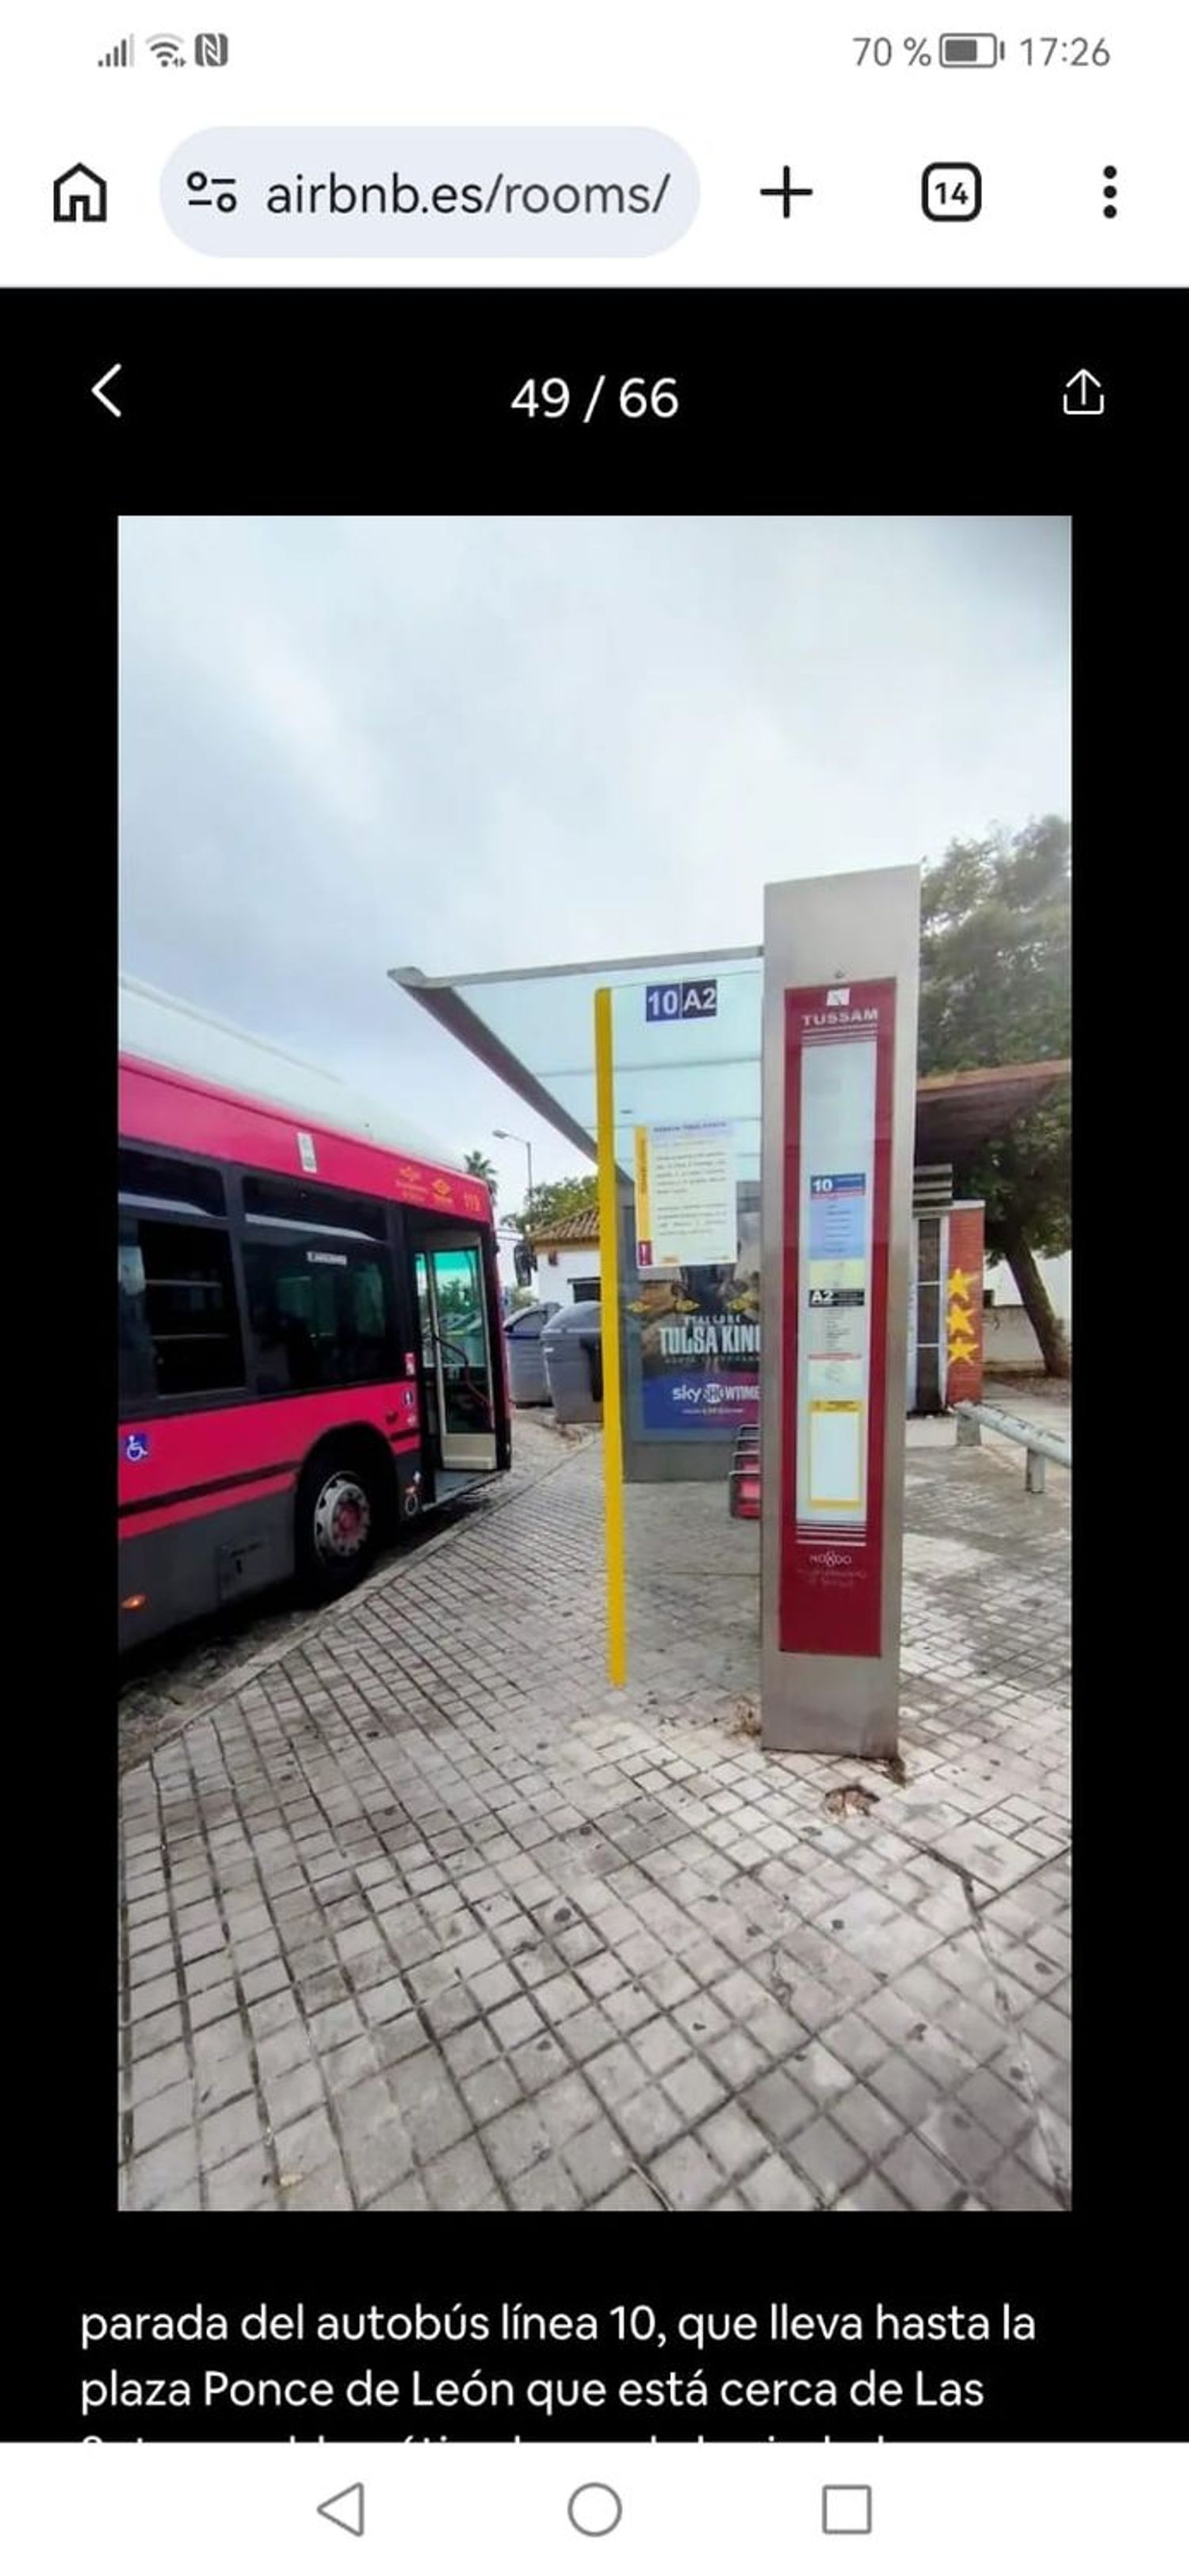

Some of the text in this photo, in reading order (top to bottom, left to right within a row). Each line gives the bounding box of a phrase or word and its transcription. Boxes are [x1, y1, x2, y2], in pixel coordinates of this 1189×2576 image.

[853, 37, 931, 66] 70 %
[1021, 37, 1110, 67] 17:26
[267, 172, 671, 213] airbnb.es/rooms/
[935, 182, 968, 204] 14
[511, 375, 678, 423] 49 / 66
[648, 987, 717, 1016] 10 A2
[802, 1009, 878, 1027] TUSSAM
[812, 1177, 833, 1193] 10
[812, 1289, 833, 1305] A2
[659, 1326, 718, 1357] TULSA
[82, 2303, 1034, 2350] parada del autobús línea 10, que lleva hasta la
[82, 2369, 984, 2416] plaza Ponce de León que está cerca de Las
